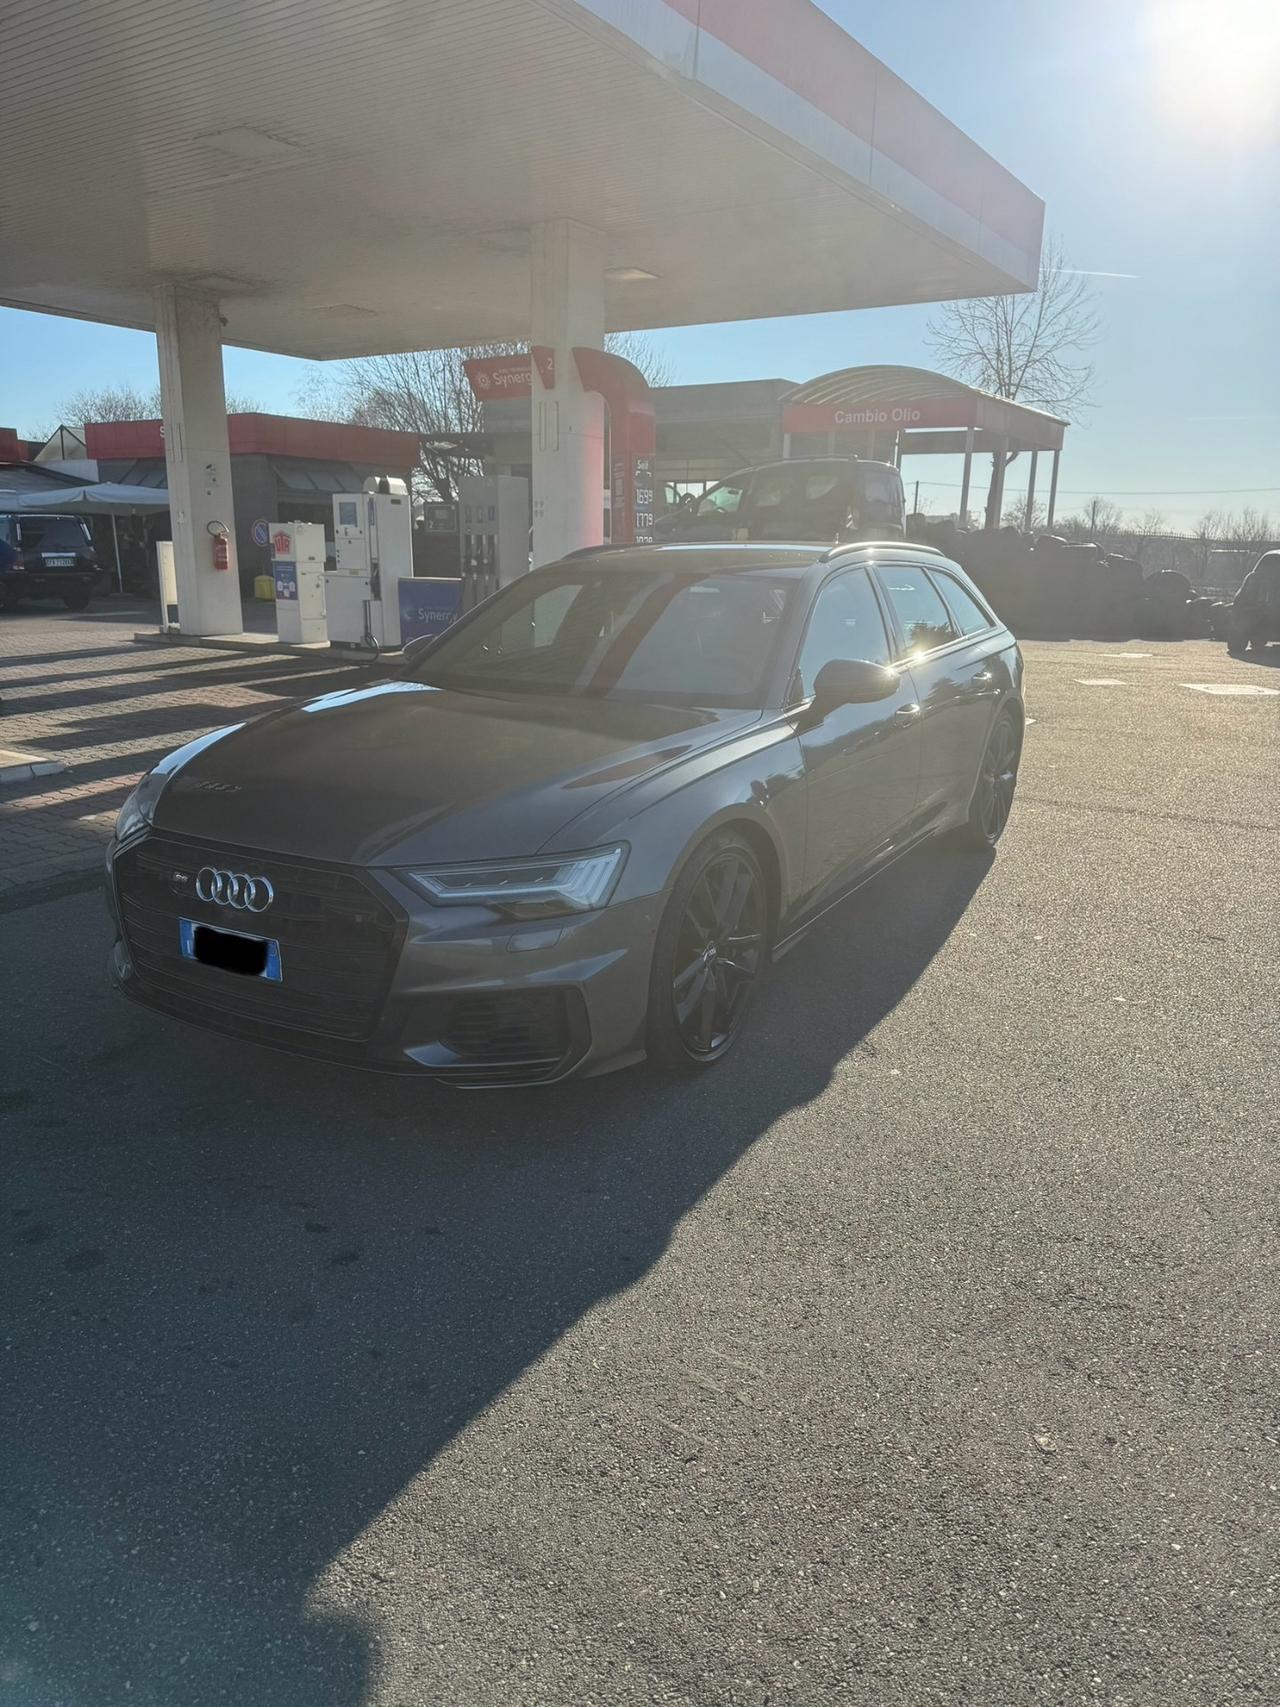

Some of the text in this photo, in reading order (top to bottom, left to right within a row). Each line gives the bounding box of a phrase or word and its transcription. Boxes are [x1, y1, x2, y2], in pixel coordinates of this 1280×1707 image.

[547, 357, 553, 370] 2
[835, 408, 921, 424] Cambio Olio
